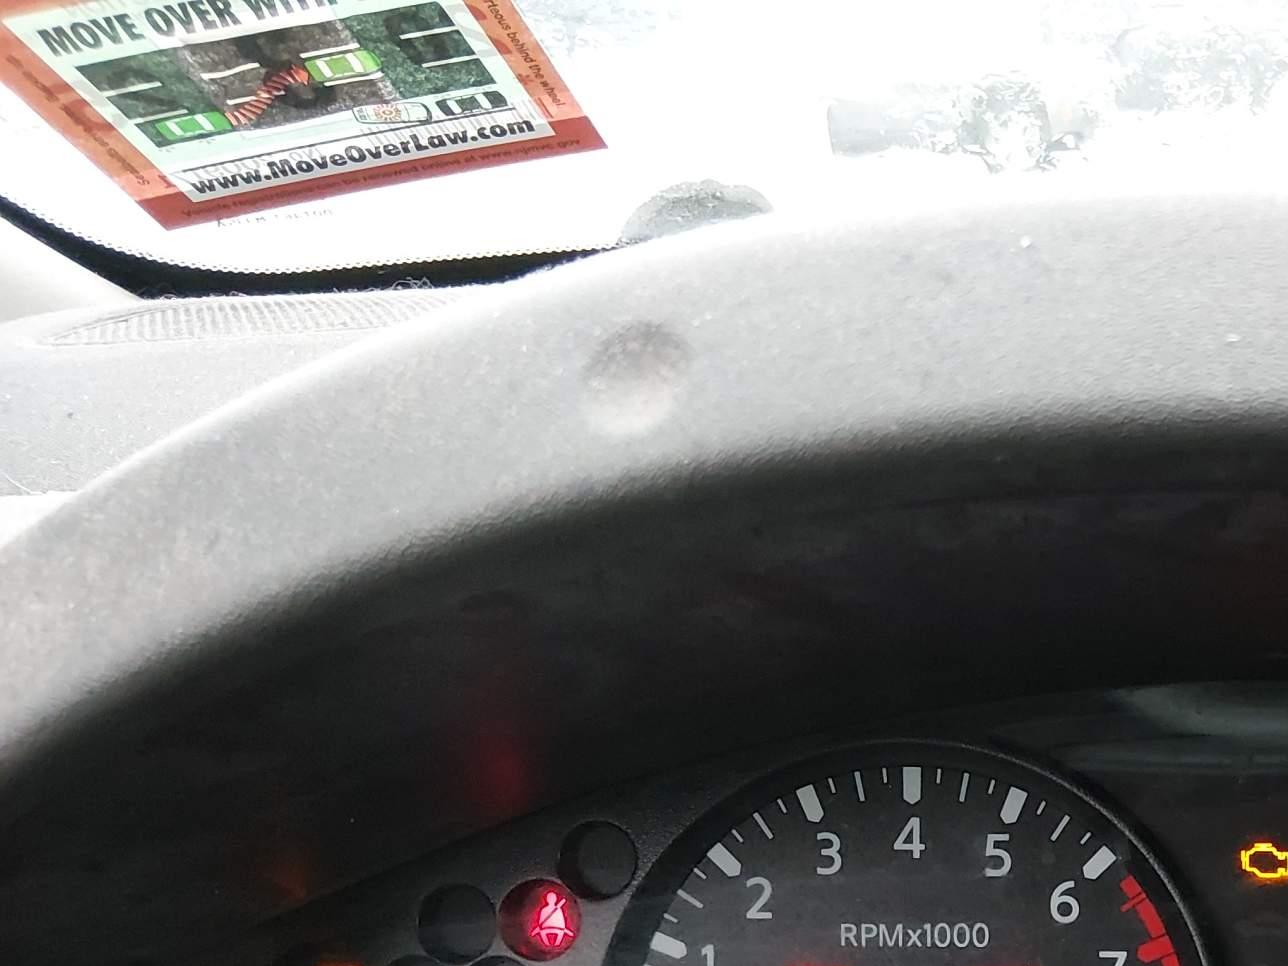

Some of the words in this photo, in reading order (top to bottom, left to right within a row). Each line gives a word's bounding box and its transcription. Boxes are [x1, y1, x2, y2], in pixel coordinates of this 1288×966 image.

[36, 13, 146, 57] MOVE
[144, 0, 242, 38] OVER
[507, 31, 537, 63] behind
[528, 64, 545, 80] the
[191, 118, 536, 195] www.MoveOverLaw.com
[816, 832, 842, 876] 3
[893, 817, 926, 859] 4
[985, 834, 1012, 877] 5
[745, 877, 773, 919] 2
[1050, 881, 1080, 924] 6
[840, 922, 990, 948] RPMx1000
